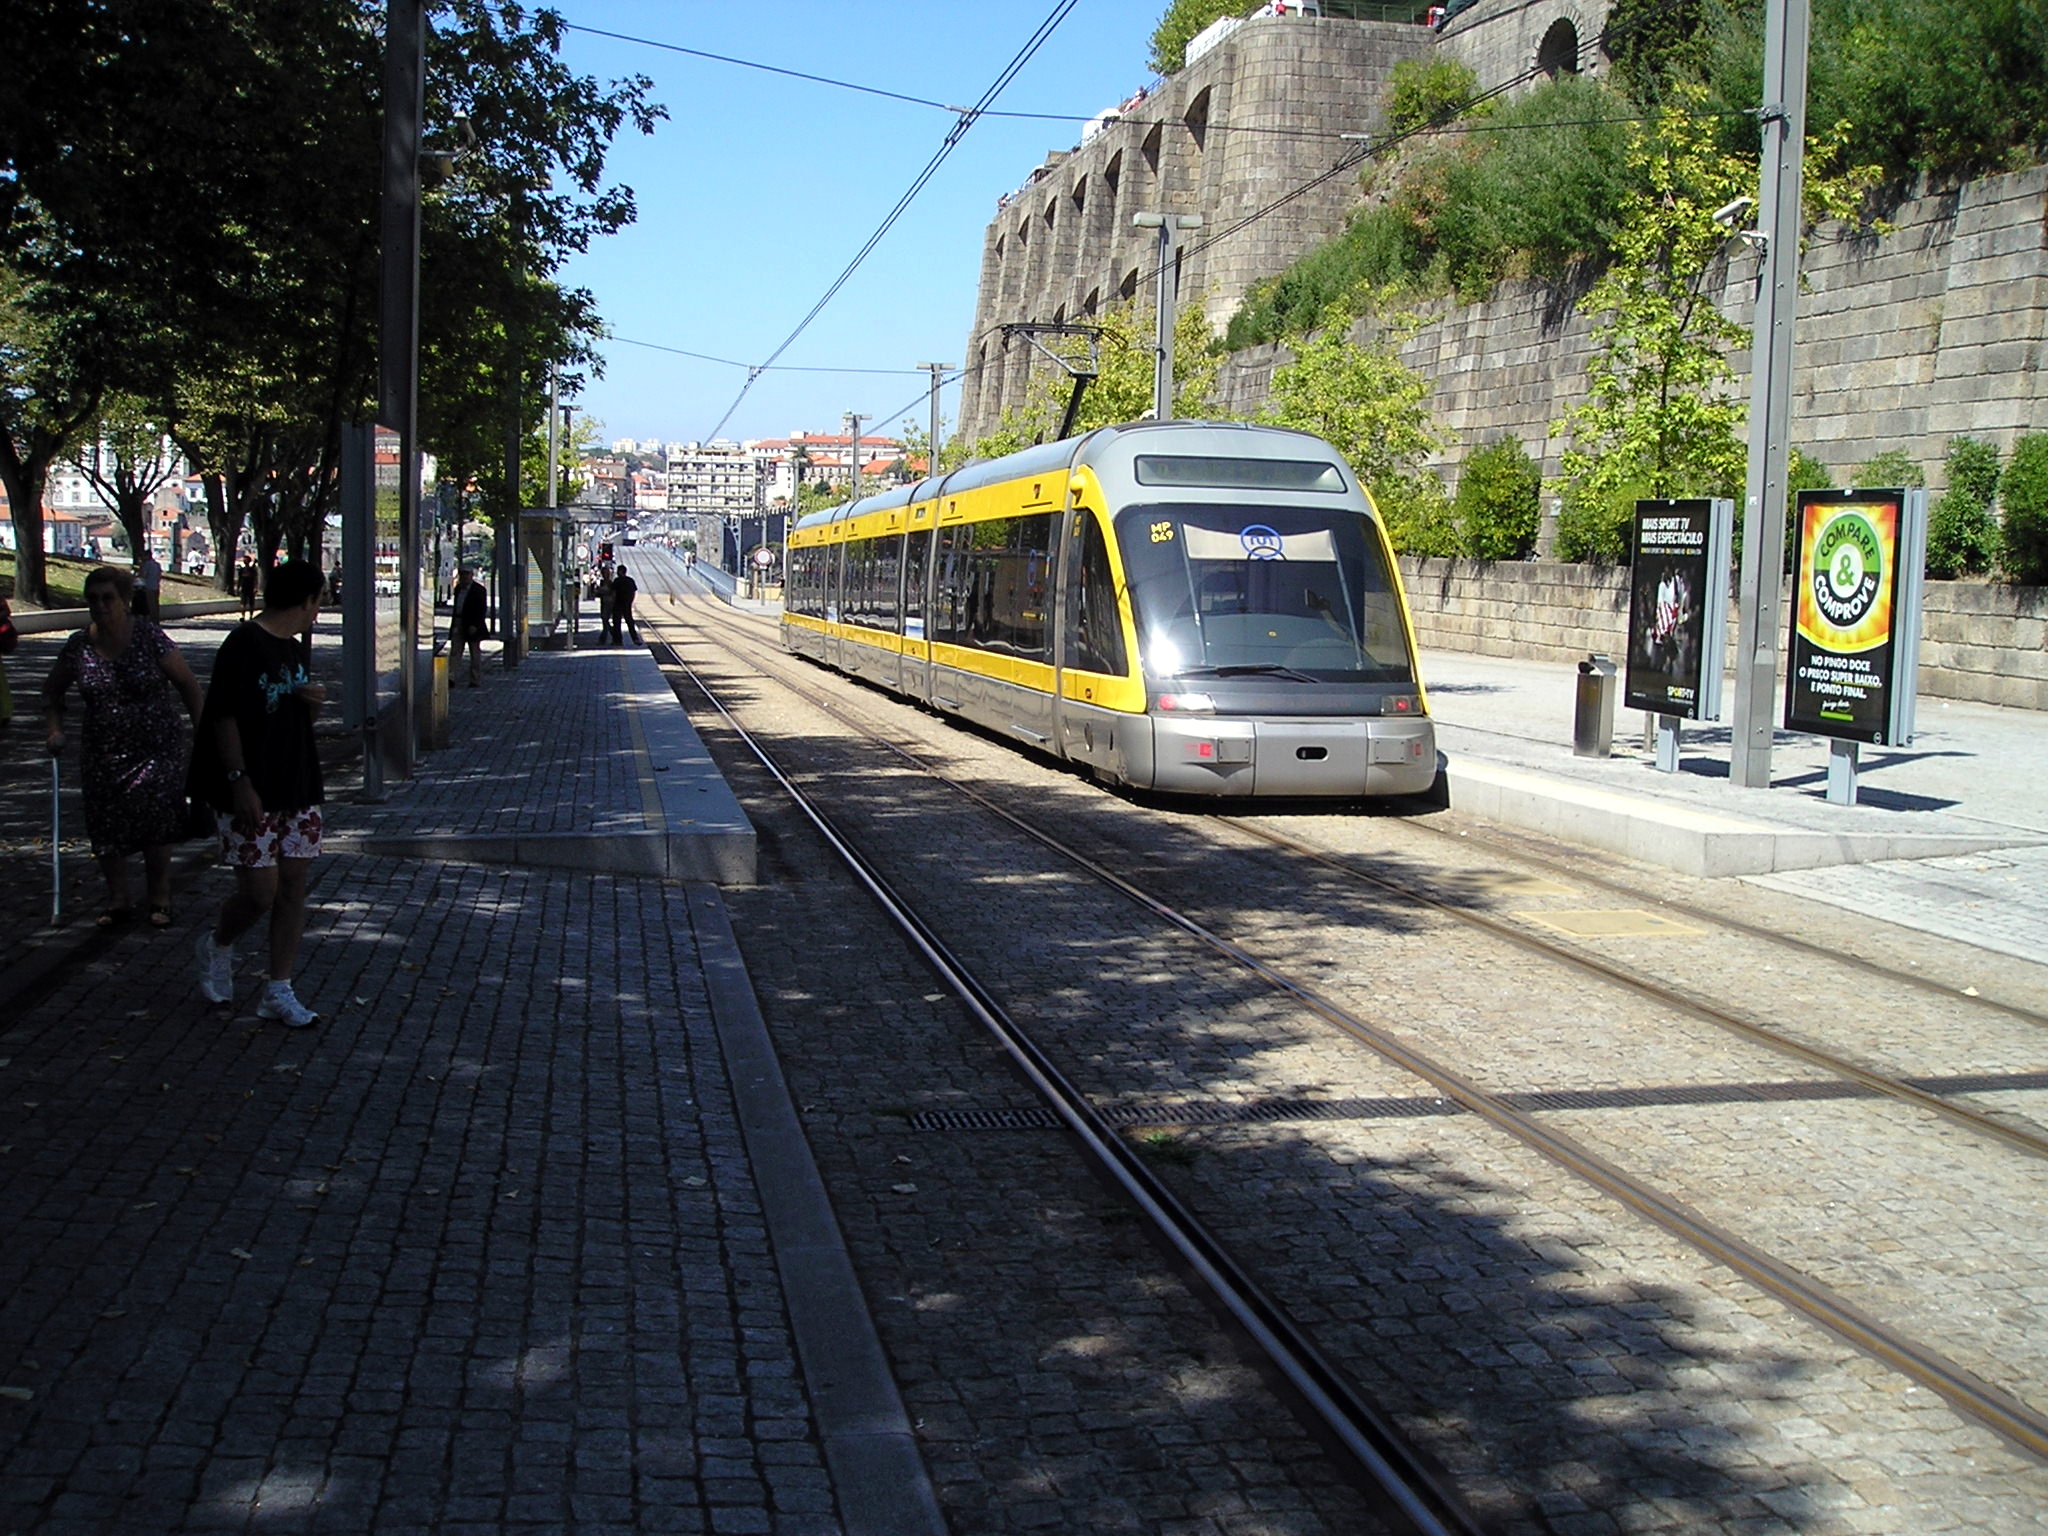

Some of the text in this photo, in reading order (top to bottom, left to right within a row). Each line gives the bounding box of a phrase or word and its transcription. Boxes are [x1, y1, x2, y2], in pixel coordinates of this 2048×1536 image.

[1151, 521, 1171, 533] MP
[1642, 518, 1690, 530] MAIS SPORT TV
[1151, 530, 1174, 543] 049
[1641, 532, 1656, 544] MAIS
[1821, 522, 1875, 560] COMPARE
[1836, 554, 1855, 586] &
[1815, 575, 1876, 619] COMPROVE
[1811, 655, 1871, 672] NO PINGO DOCE
[1799, 666, 1806, 677] O
[1831, 670, 1853, 683] SUPER
[1810, 681, 1816, 692] E
[1816, 682, 1842, 695] PONTO
